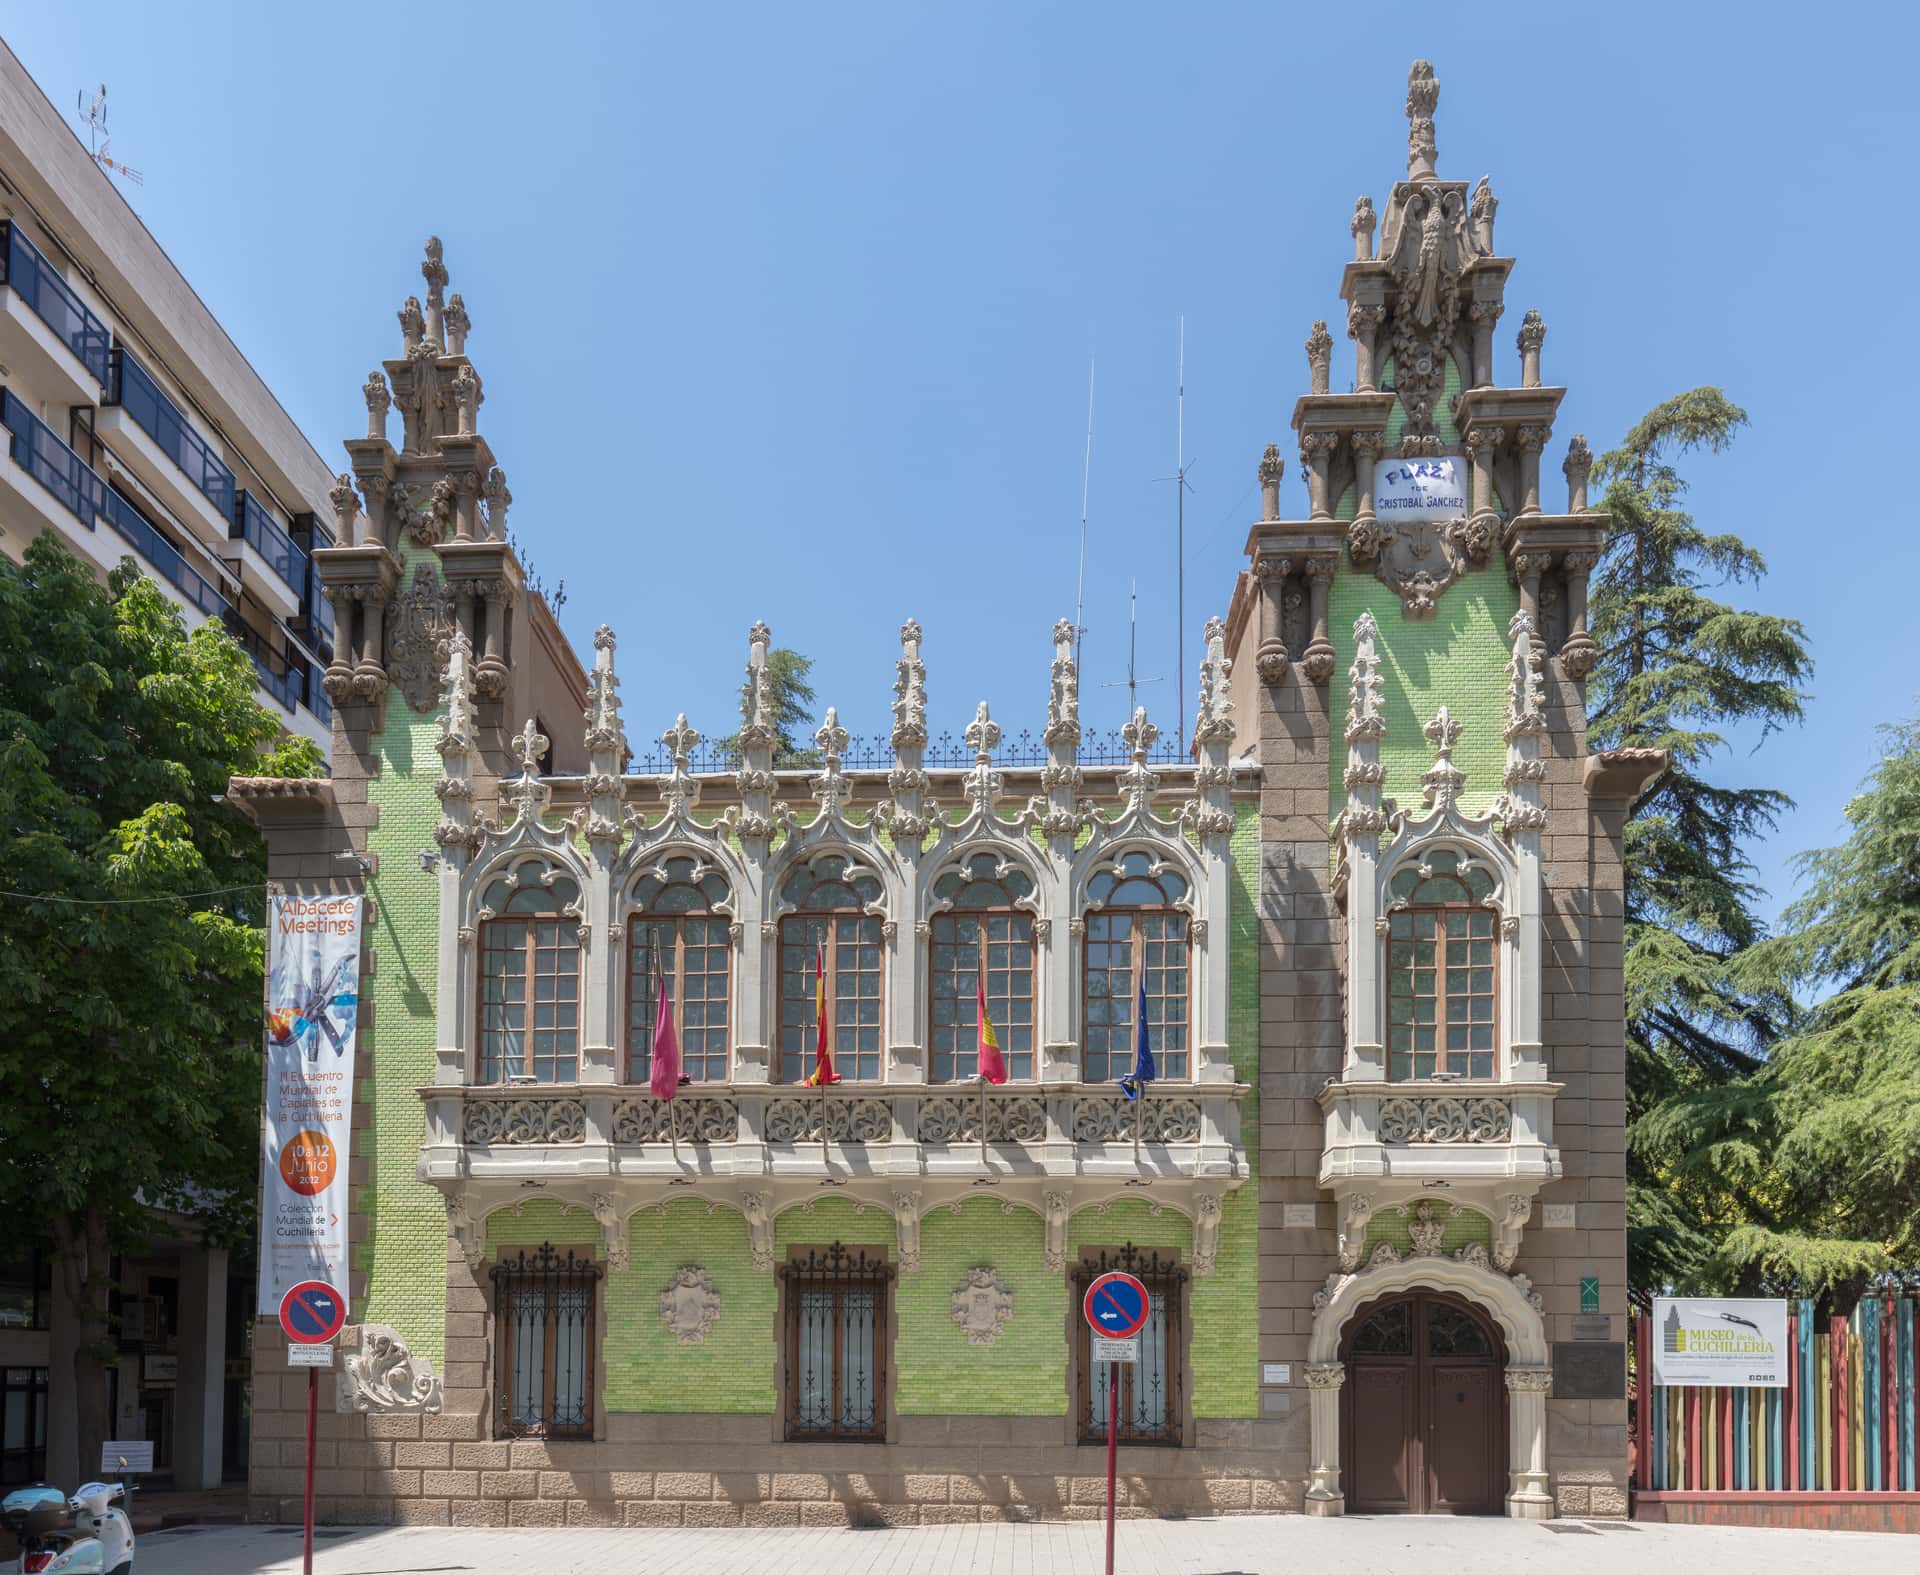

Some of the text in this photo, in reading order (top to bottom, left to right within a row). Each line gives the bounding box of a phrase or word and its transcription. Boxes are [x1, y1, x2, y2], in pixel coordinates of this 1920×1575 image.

[279, 899, 355, 916] Albacete
[278, 917, 355, 936] Meetings
[279, 1085, 338, 1096] Mundial de
[329, 1098, 342, 1107] de
[315, 1144, 329, 1157] 12
[299, 1176, 321, 1184] 2022
[275, 1215, 326, 1225] Mundial de
[1690, 1328, 1735, 1340] MUSEO
